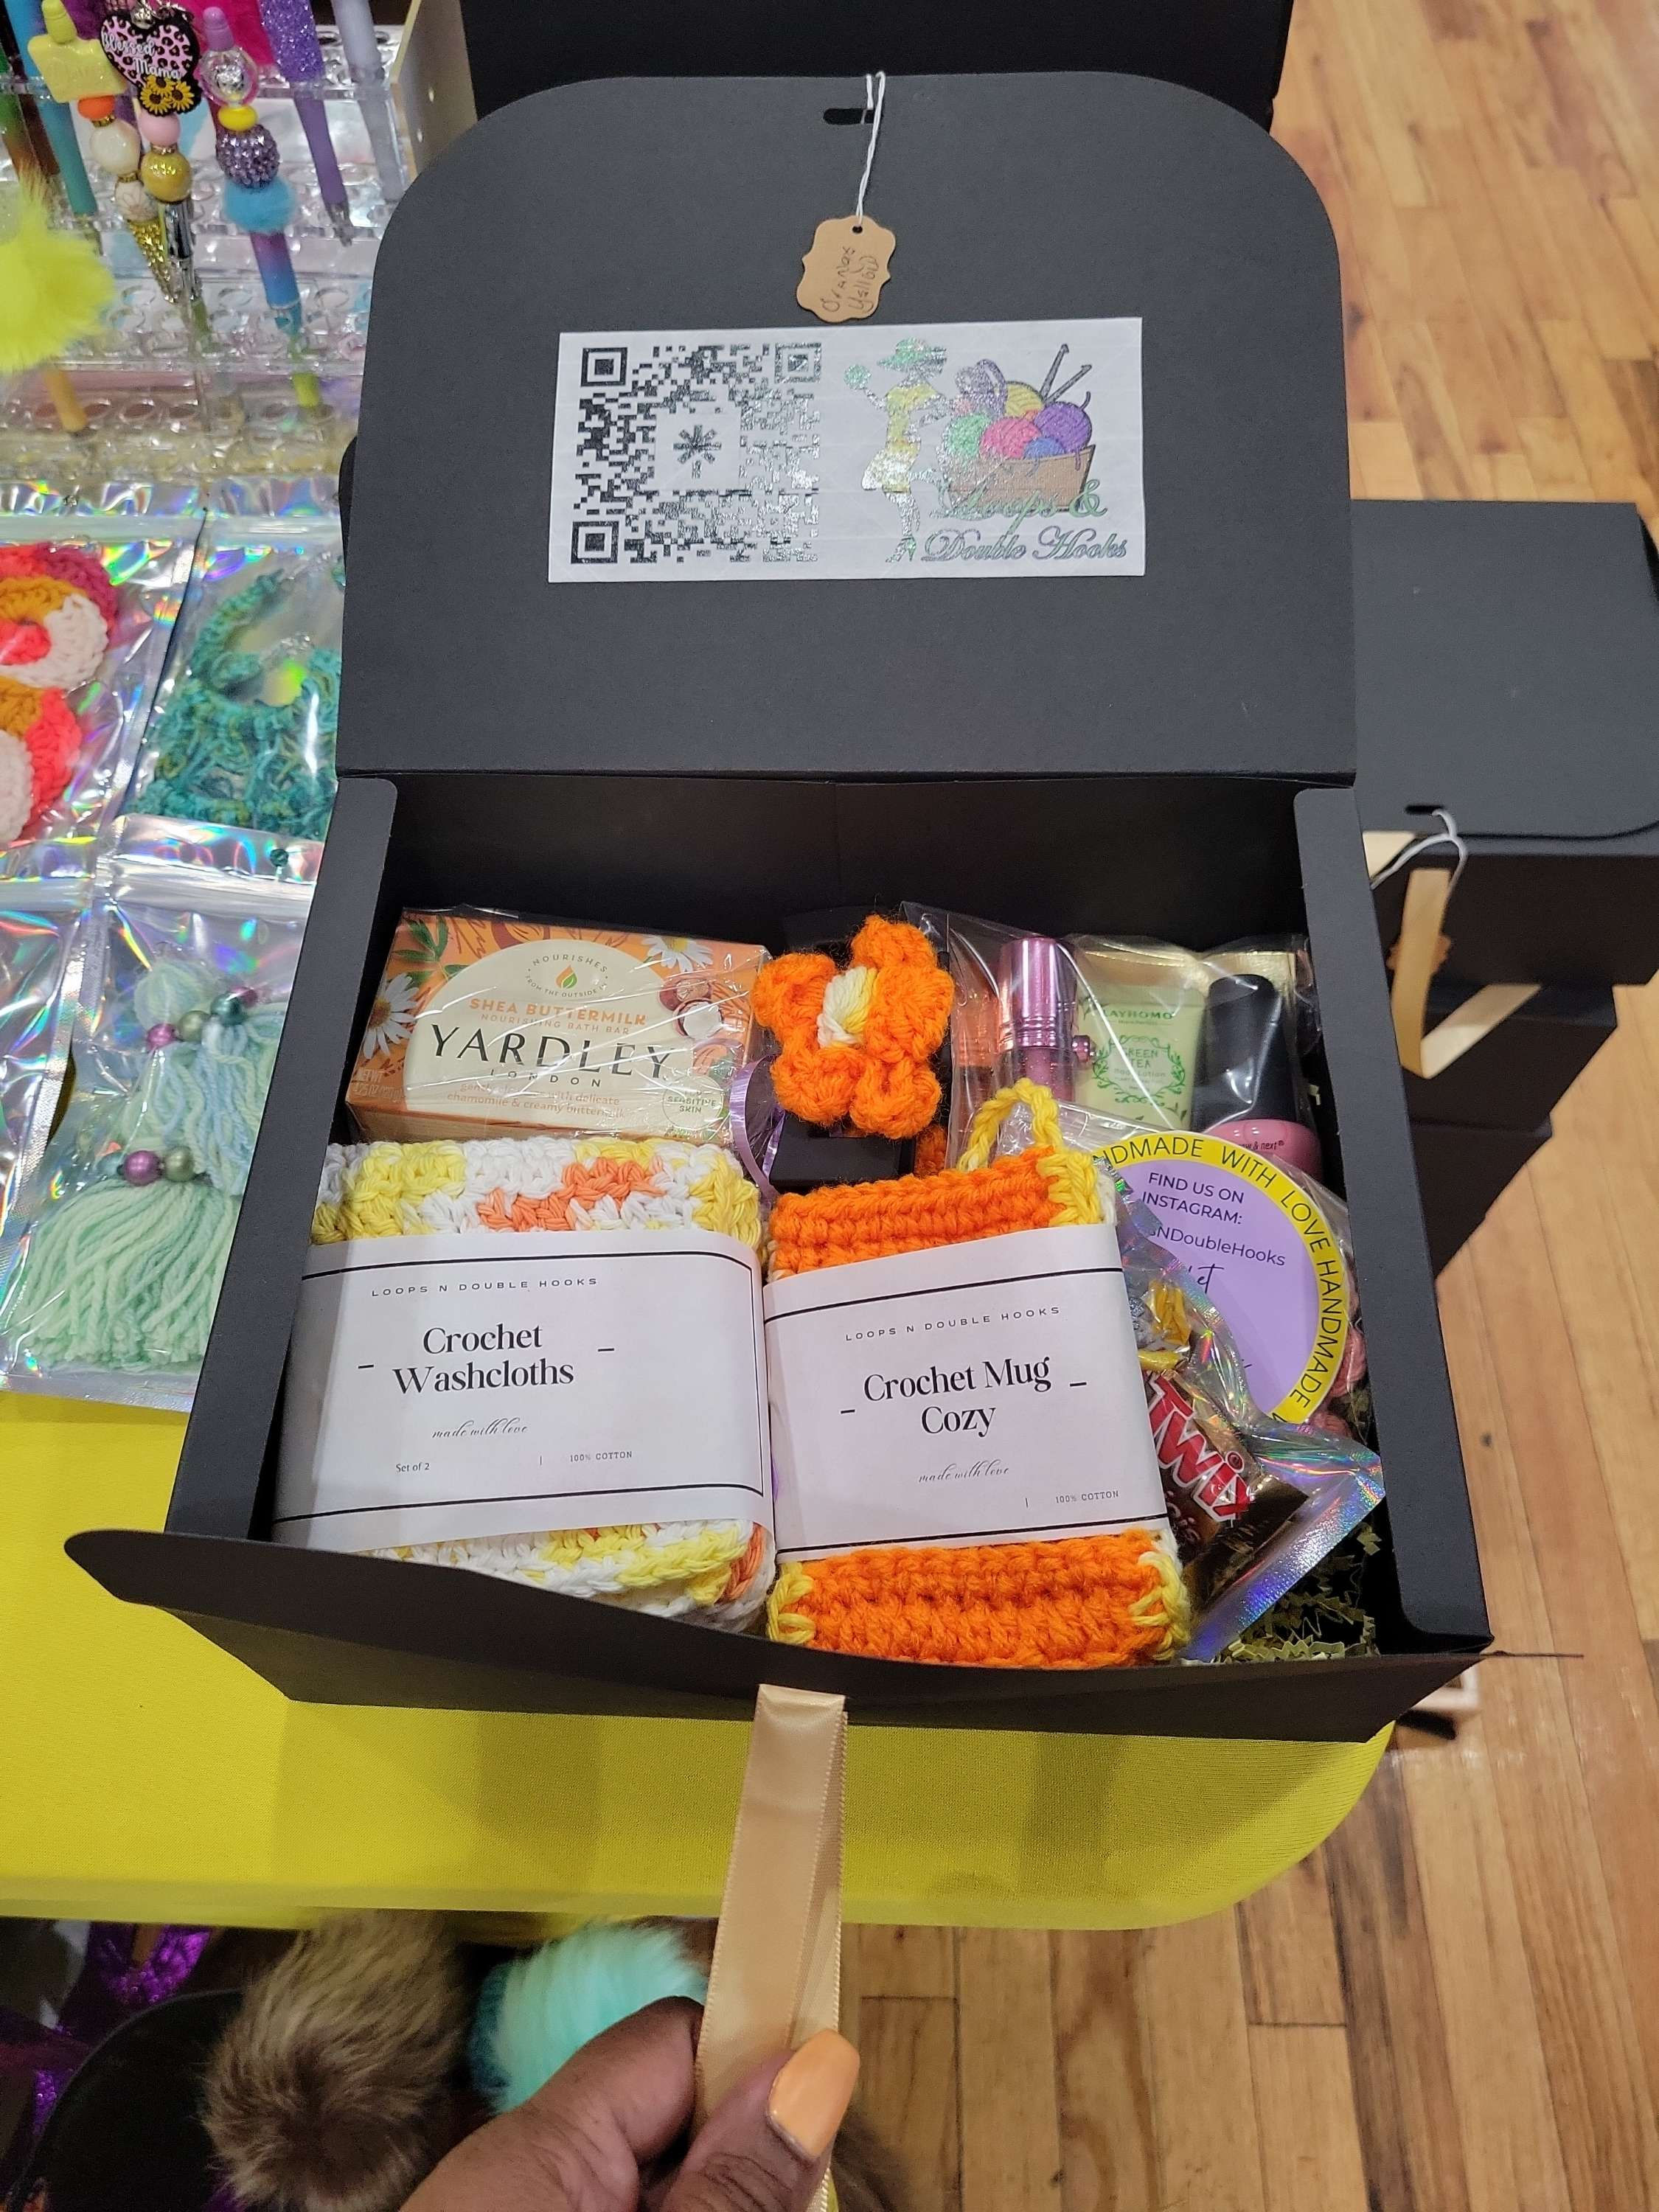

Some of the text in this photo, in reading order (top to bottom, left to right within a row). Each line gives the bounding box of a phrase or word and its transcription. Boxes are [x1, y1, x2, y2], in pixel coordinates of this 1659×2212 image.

[101, 27, 156, 57] Blessed
[133, 58, 182, 79] Mama
[1067, 479, 1108, 517] &
[921, 525, 1127, 561] Double Hooks
[532, 954, 608, 973] NOURISHES
[561, 989, 597, 998] OUTSIDE
[469, 998, 646, 1026] SHEA BUTTERMILK
[481, 1014, 629, 1035] NOURISHING BATH BAR
[431, 1023, 674, 1079] YARDLEY
[447, 1093, 508, 1106] chamomile
[512, 1096, 520, 1106] &
[524, 1099, 563, 1113] creamy
[680, 1105, 702, 1113] SKIN
[1221, 1146, 1277, 1189] WITH
[1148, 1172, 1245, 1203] FIND US ON
[1142, 1191, 1242, 1225] INSTAGRAM:
[1281, 1189, 1330, 1253] LOVE
[372, 1285, 428, 1297] LOOPS
[459, 1281, 528, 1291] DOUBLE
[540, 1278, 597, 1288] HOOKS
[423, 1323, 542, 1354] Crochet
[846, 1306, 1060, 1342] LOOPS N DOUBLE HOOKS
[1290, 1260, 1342, 1408] HANDMADE
[393, 1358, 574, 1394] Washcloths
[863, 1356, 1052, 1402] Crochet Mug
[432, 1416, 527, 1439] made with love
[922, 1406, 995, 1437] Cozy
[396, 1462, 430, 1473] Set of 2
[570, 1450, 632, 1463] 100% COTTON
[919, 1458, 1009, 1483] made with love
[1055, 1489, 1119, 1504] 100% COTTON
